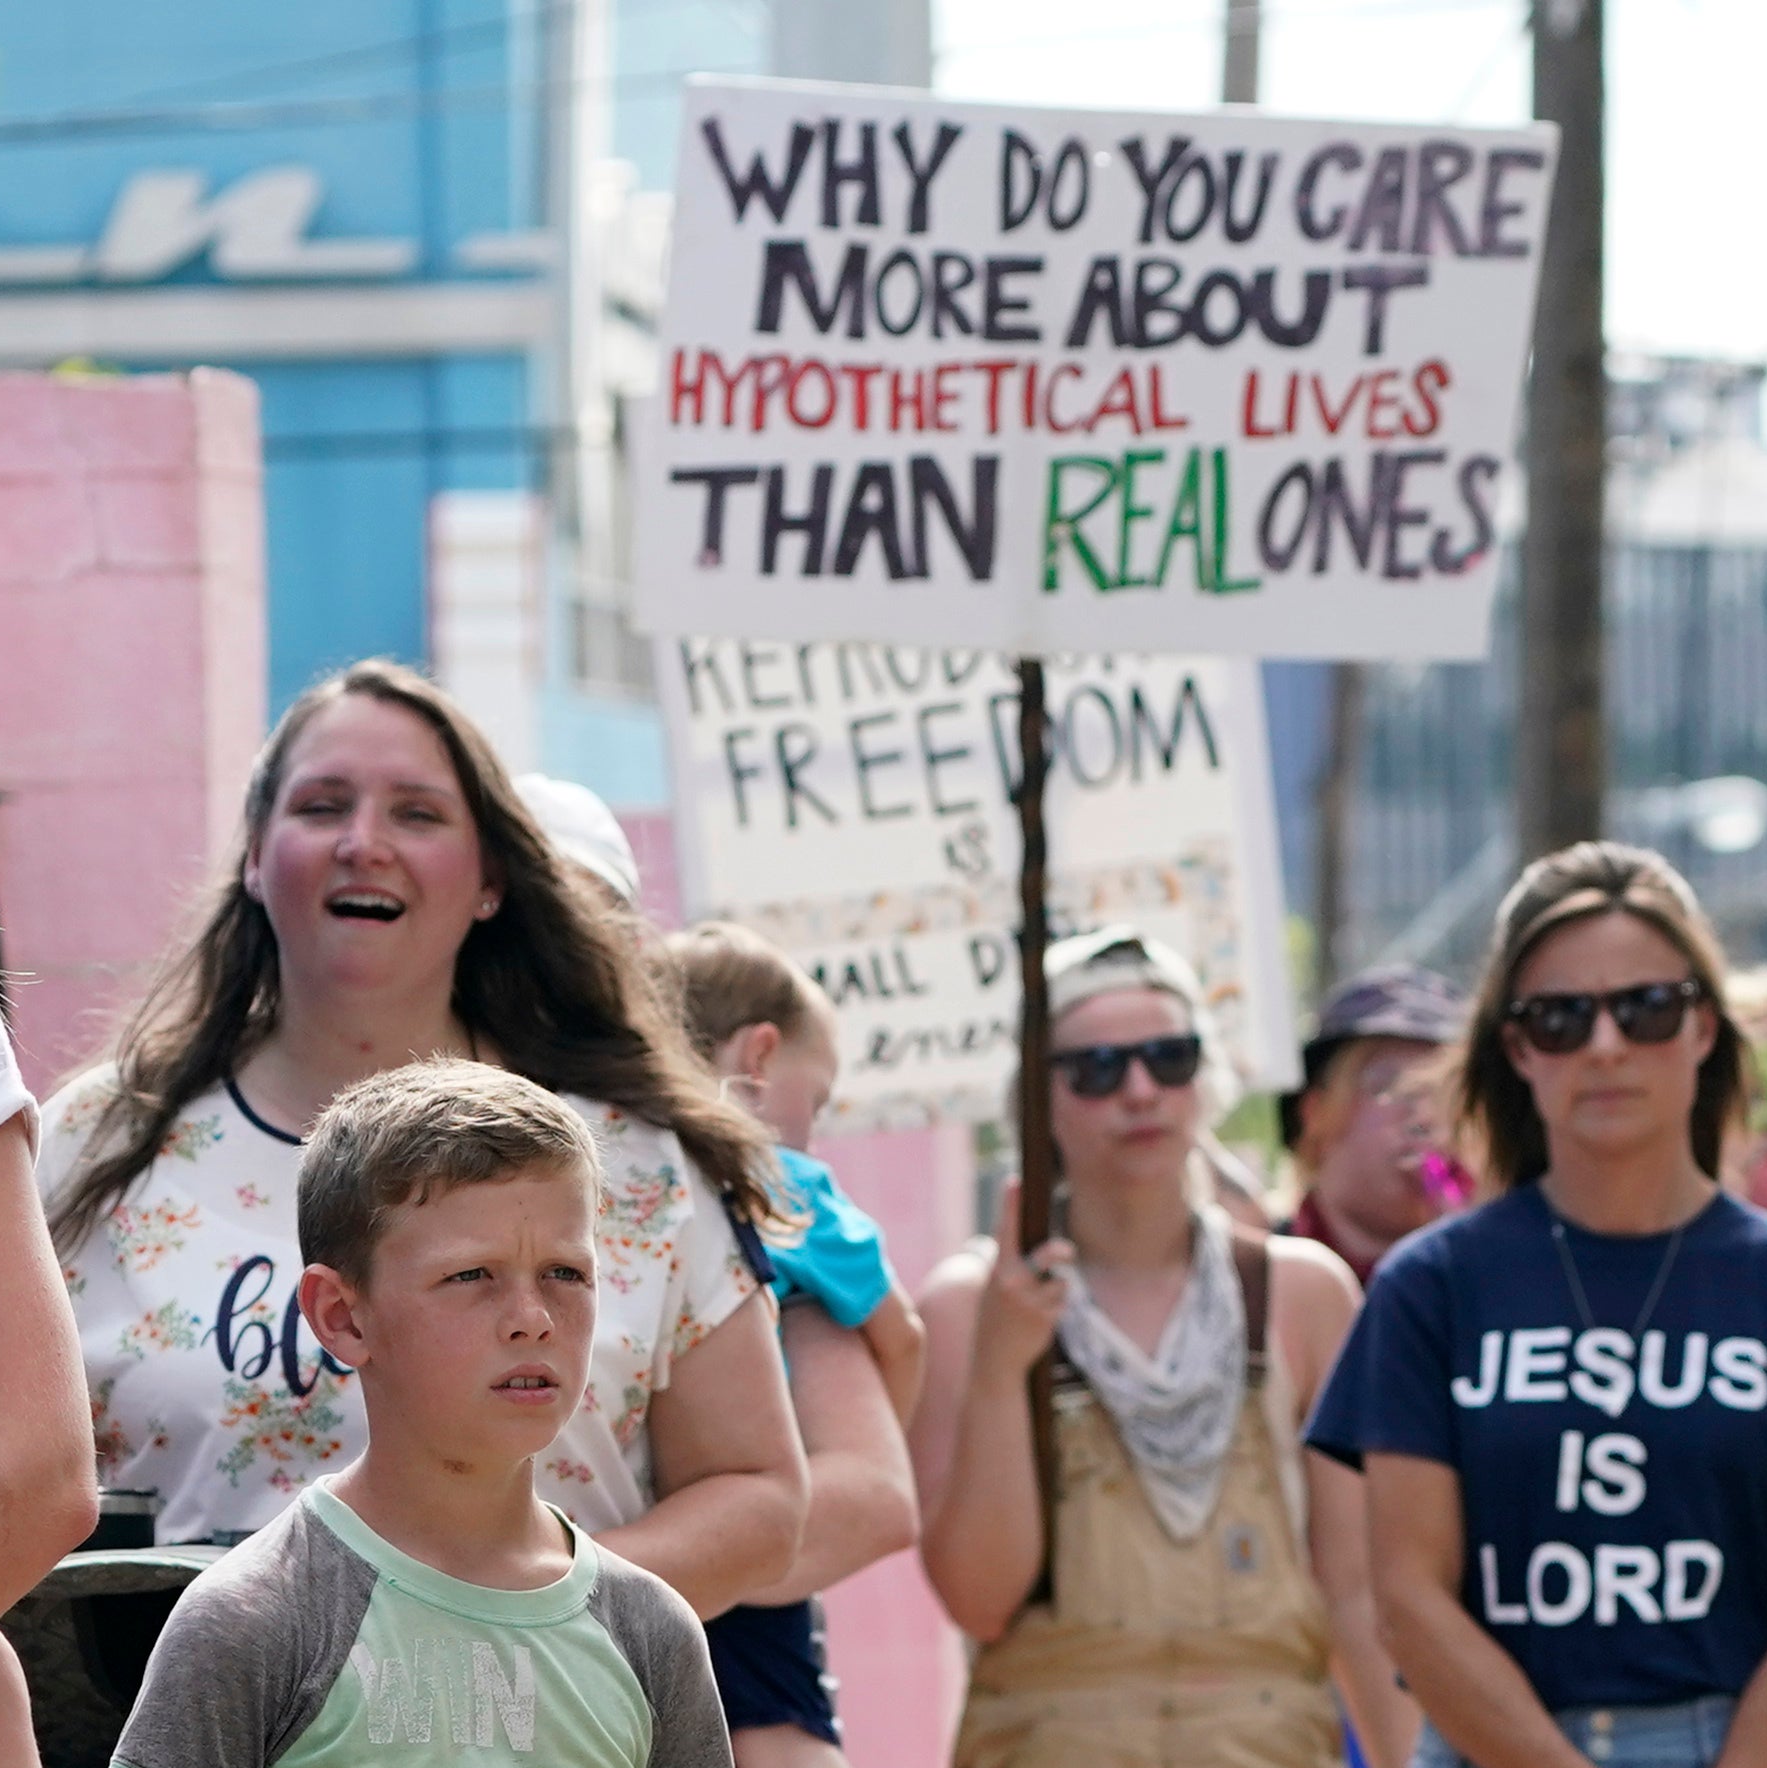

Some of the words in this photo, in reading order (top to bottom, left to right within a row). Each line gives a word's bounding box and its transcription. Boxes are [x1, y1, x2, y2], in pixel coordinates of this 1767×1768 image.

[702, 118, 964, 232] WHY
[1000, 128, 1090, 233] DO
[1120, 133, 1278, 246] YOU
[1296, 145, 1545, 258] CARE
[755, 240, 1045, 345] MORE
[1066, 258, 1428, 355] ABOUT
[669, 350, 1192, 437] HYPOTHETICAL
[1242, 358, 1454, 440] LIVES
[670, 456, 1000, 582] THAN
[1042, 446, 1262, 594] REAL
[1258, 450, 1502, 578] ONES
[1555, 1430, 1649, 1516] IS
[1480, 1540, 1724, 1627] LORD
[347, 1638, 535, 1752] WIN
